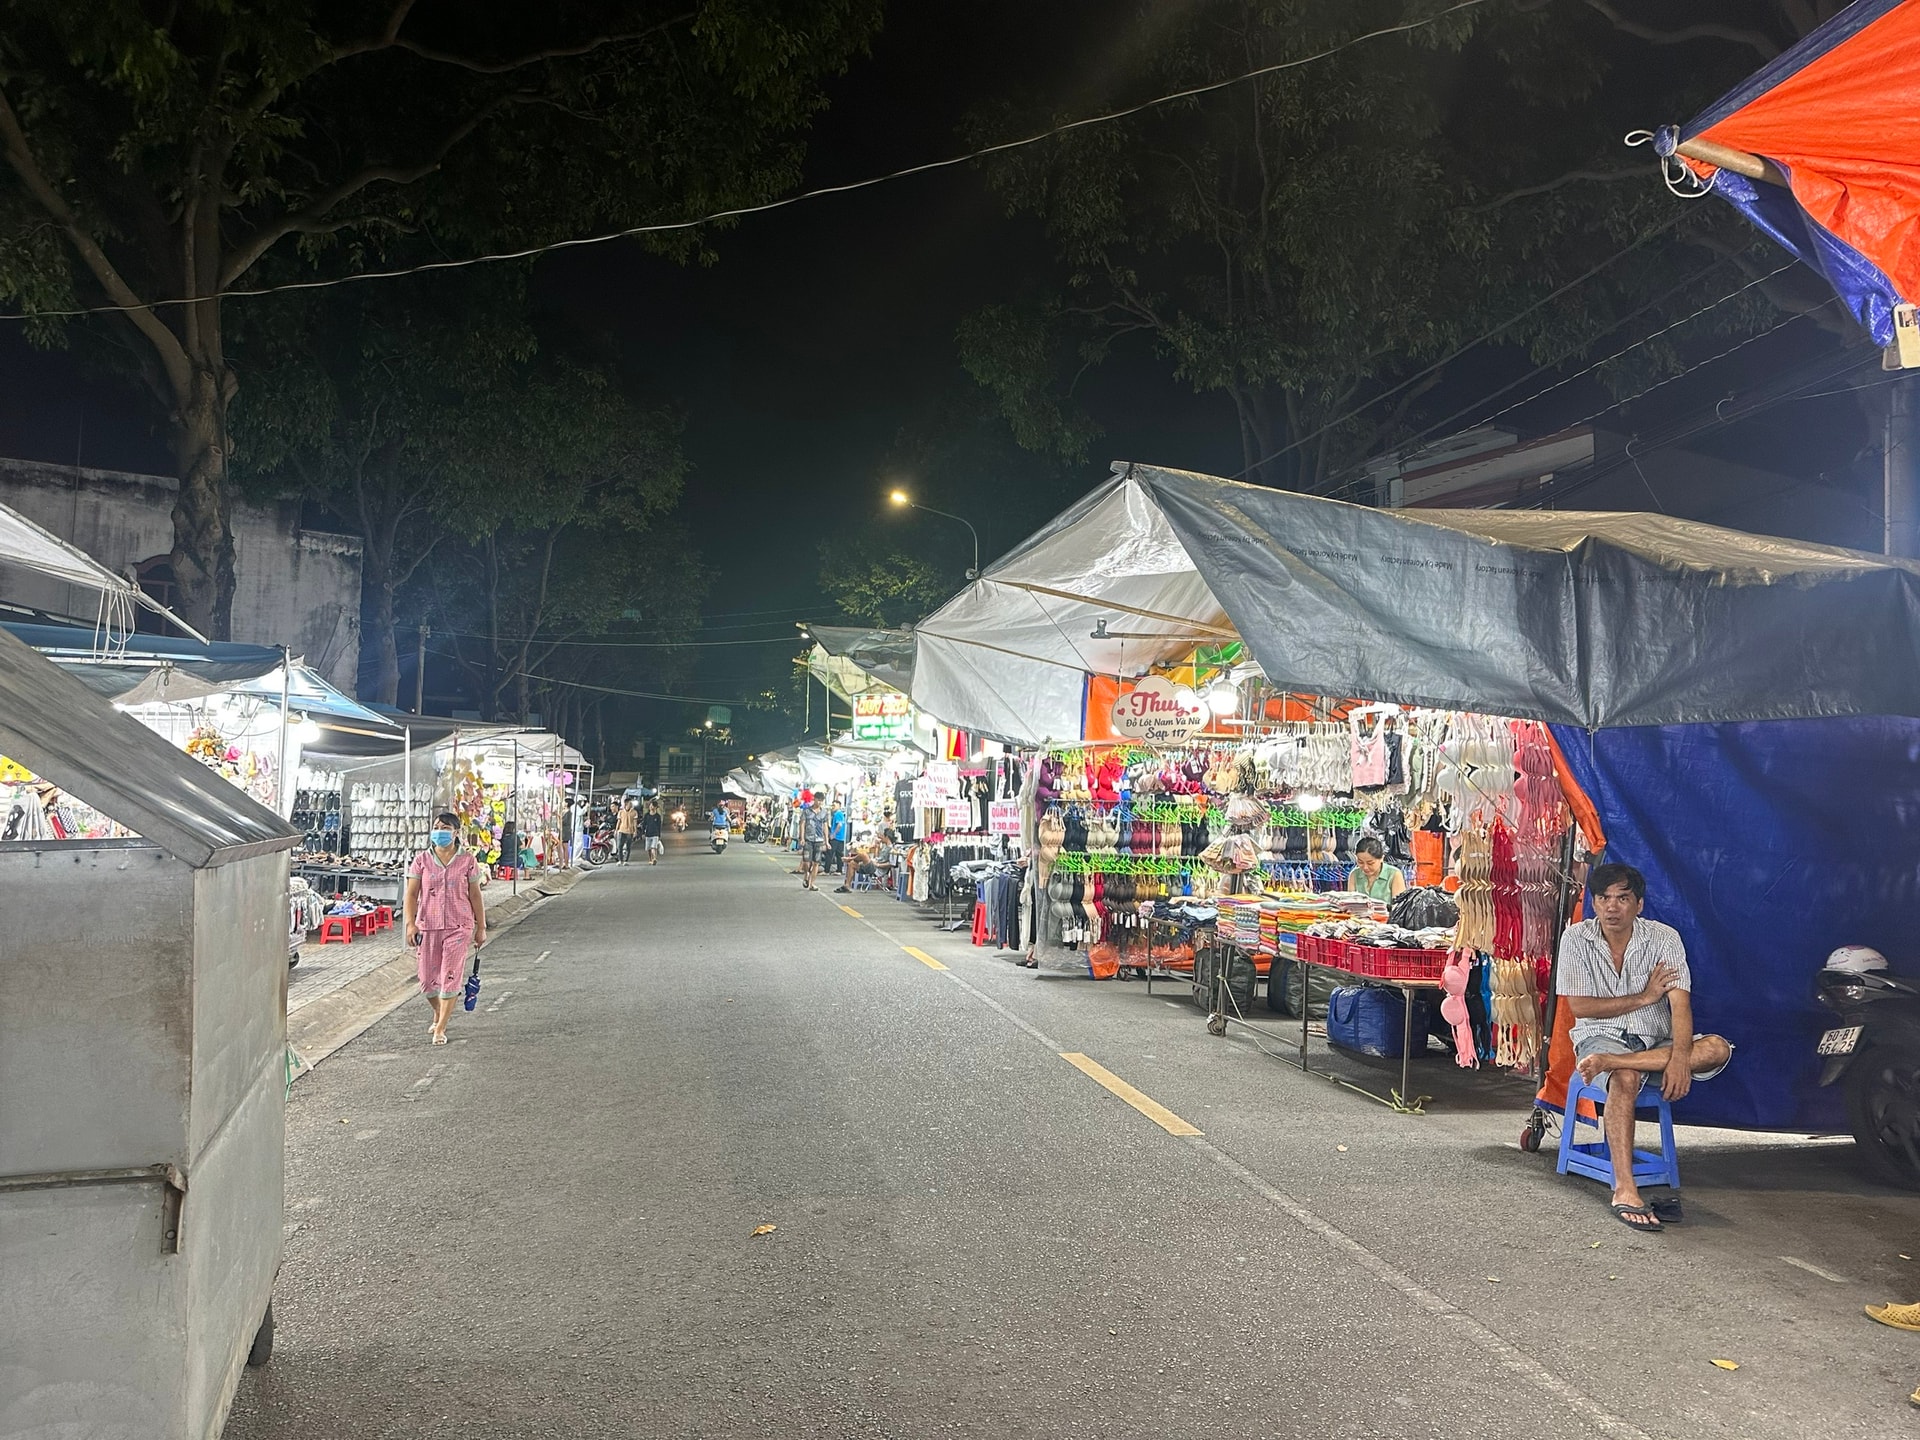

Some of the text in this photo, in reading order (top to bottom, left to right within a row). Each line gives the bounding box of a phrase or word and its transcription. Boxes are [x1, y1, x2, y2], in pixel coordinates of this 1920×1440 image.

[1287, 546, 1358, 562] Made by Korean factory
[1381, 555, 1453, 570] Made by Korean factory
[1475, 564, 1544, 580] Made by Korean factory
[1140, 718, 1152, 727] Lót
[1154, 718, 1174, 726] Nam
[1146, 727, 1187, 740] Sạp 117
[1826, 1028, 1855, 1042] 60-B1
[1820, 1040, 1854, 1054] 564.25
